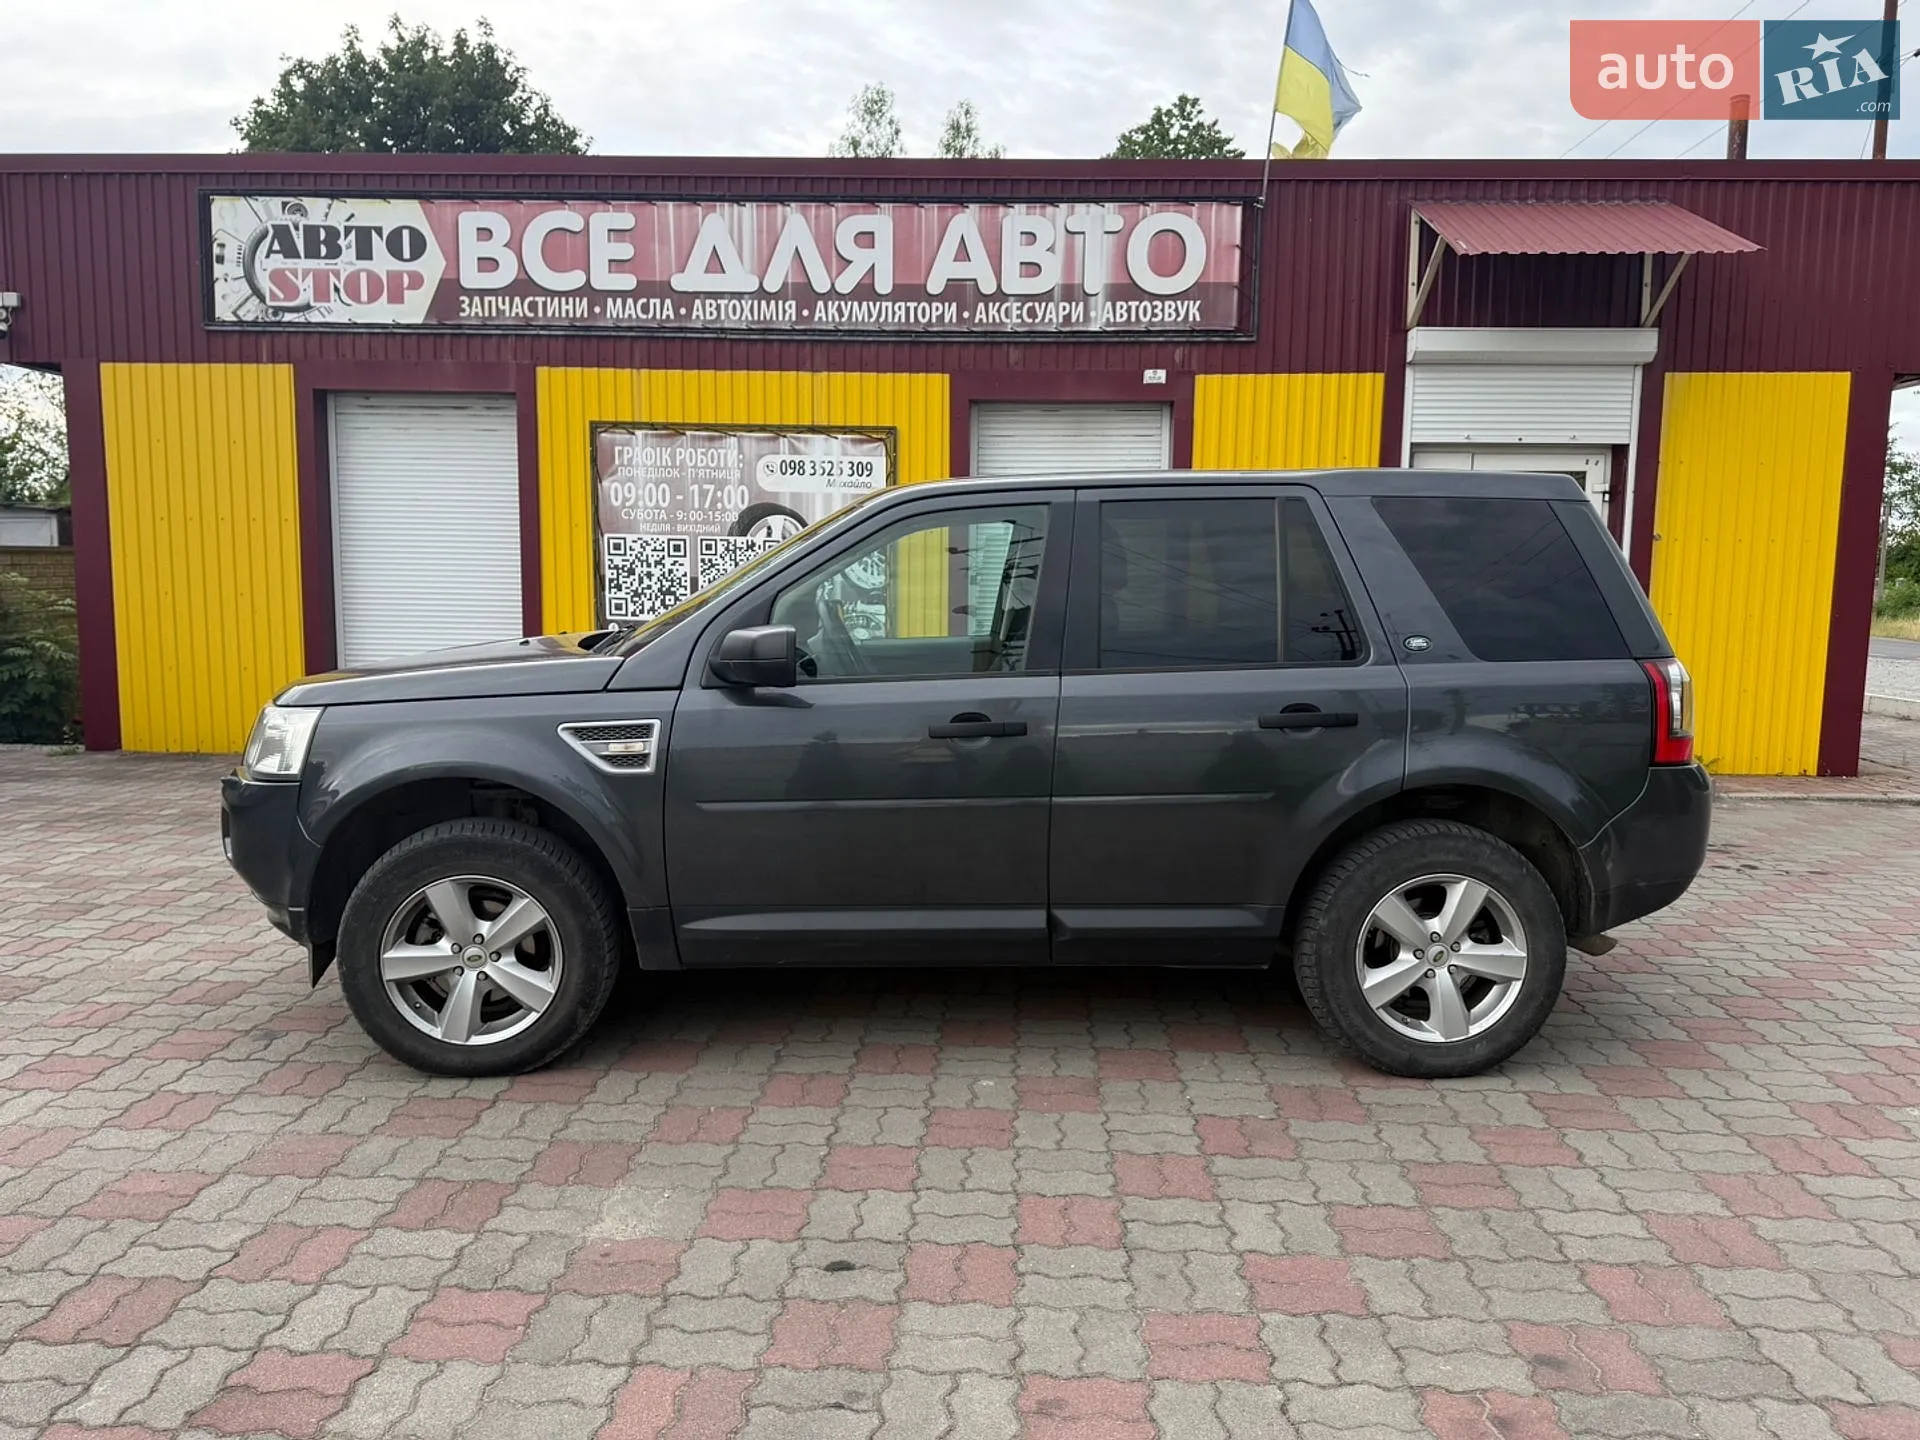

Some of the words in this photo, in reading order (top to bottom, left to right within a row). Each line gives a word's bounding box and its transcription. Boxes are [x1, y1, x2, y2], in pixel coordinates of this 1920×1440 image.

[264, 223, 428, 263] АВТО
[457, 209, 638, 292] ВСЕ
[669, 212, 894, 295] ДЛЯ
[925, 211, 1207, 296] АВТО
[267, 267, 425, 305] STOP
[458, 295, 588, 318] ЗАПЧАСТИНИ
[606, 297, 675, 320] МАСЛА
[691, 299, 797, 322] АВТОХІМІЯ
[813, 301, 957, 324] АКУМУЛЯТОРИ
[974, 301, 1084, 324] АКСЕСУАРИ
[1104, 300, 1202, 323] АВТОЗВУК
[614, 446, 672, 467] ГРАФІК
[675, 448, 744, 469] РОБОТИ:
[779, 459, 806, 476] 098
[847, 461, 874, 478] 309
[609, 482, 671, 508] 09:00
[689, 484, 750, 510] 17:00
[825, 478, 873, 490] Мхайло
[621, 508, 668, 521] СУБОТА
